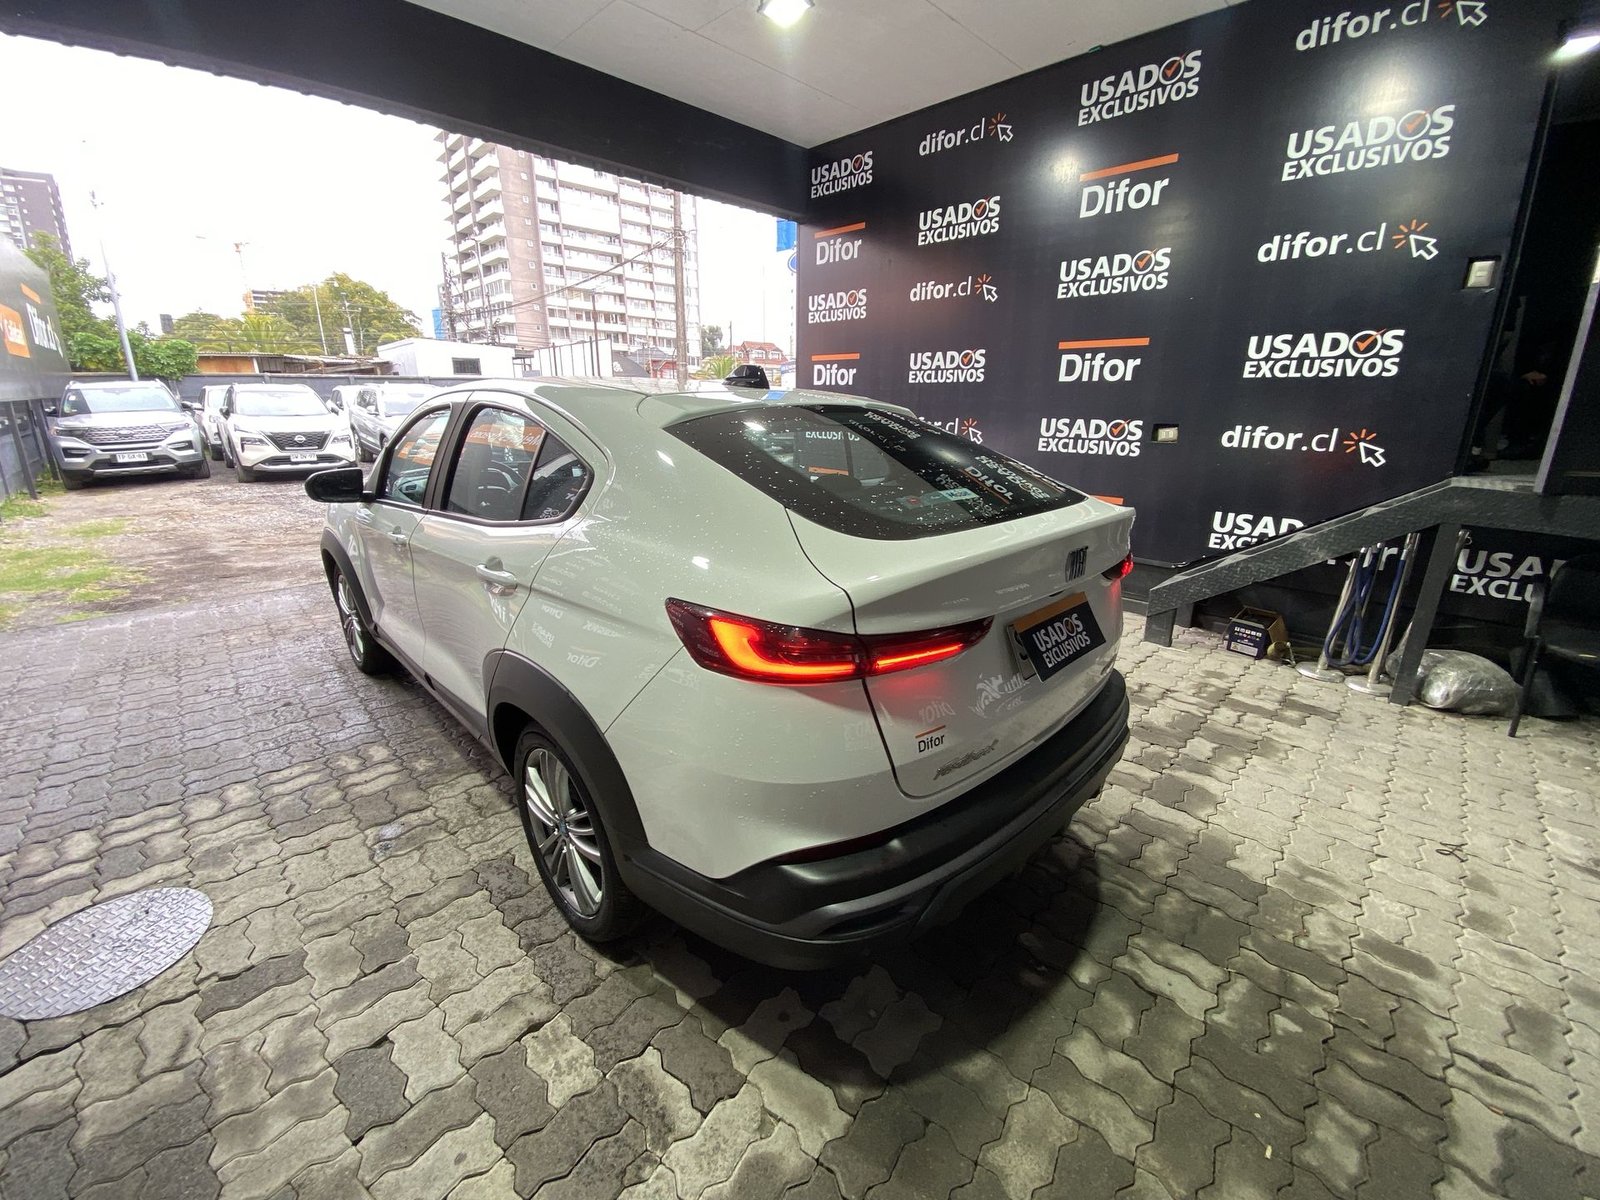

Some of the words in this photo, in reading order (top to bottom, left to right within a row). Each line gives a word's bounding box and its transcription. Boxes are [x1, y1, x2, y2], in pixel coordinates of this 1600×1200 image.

[1295, 0, 1429, 51] difor.cl
[1081, 50, 1202, 106] USADOS
[1078, 77, 1199, 126] EXCLUSIVOS
[919, 118, 985, 156] difor.cl
[1287, 105, 1455, 159] USADOS
[811, 151, 873, 184] USADOS
[1282, 136, 1450, 182] EXCLUSIVOS
[811, 171, 873, 198] EXCLUSIVOS
[1080, 178, 1169, 218] Difor
[919, 196, 1000, 230] USADOS
[917, 218, 999, 246] EXCLUSIVOS
[1257, 222, 1387, 263] difor.cl
[817, 237, 861, 265] Difor
[1060, 248, 1171, 282] USADOS
[808, 289, 867, 310] USADOS
[910, 276, 972, 302] difor.cl
[1057, 273, 1168, 299] EXCLUSIVOS
[808, 306, 866, 324] EXCLUSIVOS
[910, 349, 985, 370] USADOS
[1248, 329, 1406, 360] USADOS
[813, 364, 856, 386] Difor
[909, 366, 984, 383] EXCLUSIVOS
[1059, 353, 1141, 383] Difor
[1243, 358, 1399, 379] EXCLUSIVOS
[1040, 418, 1143, 441] USADOS
[1221, 425, 1339, 453] difor.cl
[1038, 437, 1140, 457] EXCLUSIVOS
[1456, 549, 1567, 580] USA
[1032, 613, 1084, 652] USADOS
[1042, 631, 1091, 668] EXCLUSIVOS
[918, 734, 945, 753] Difor
